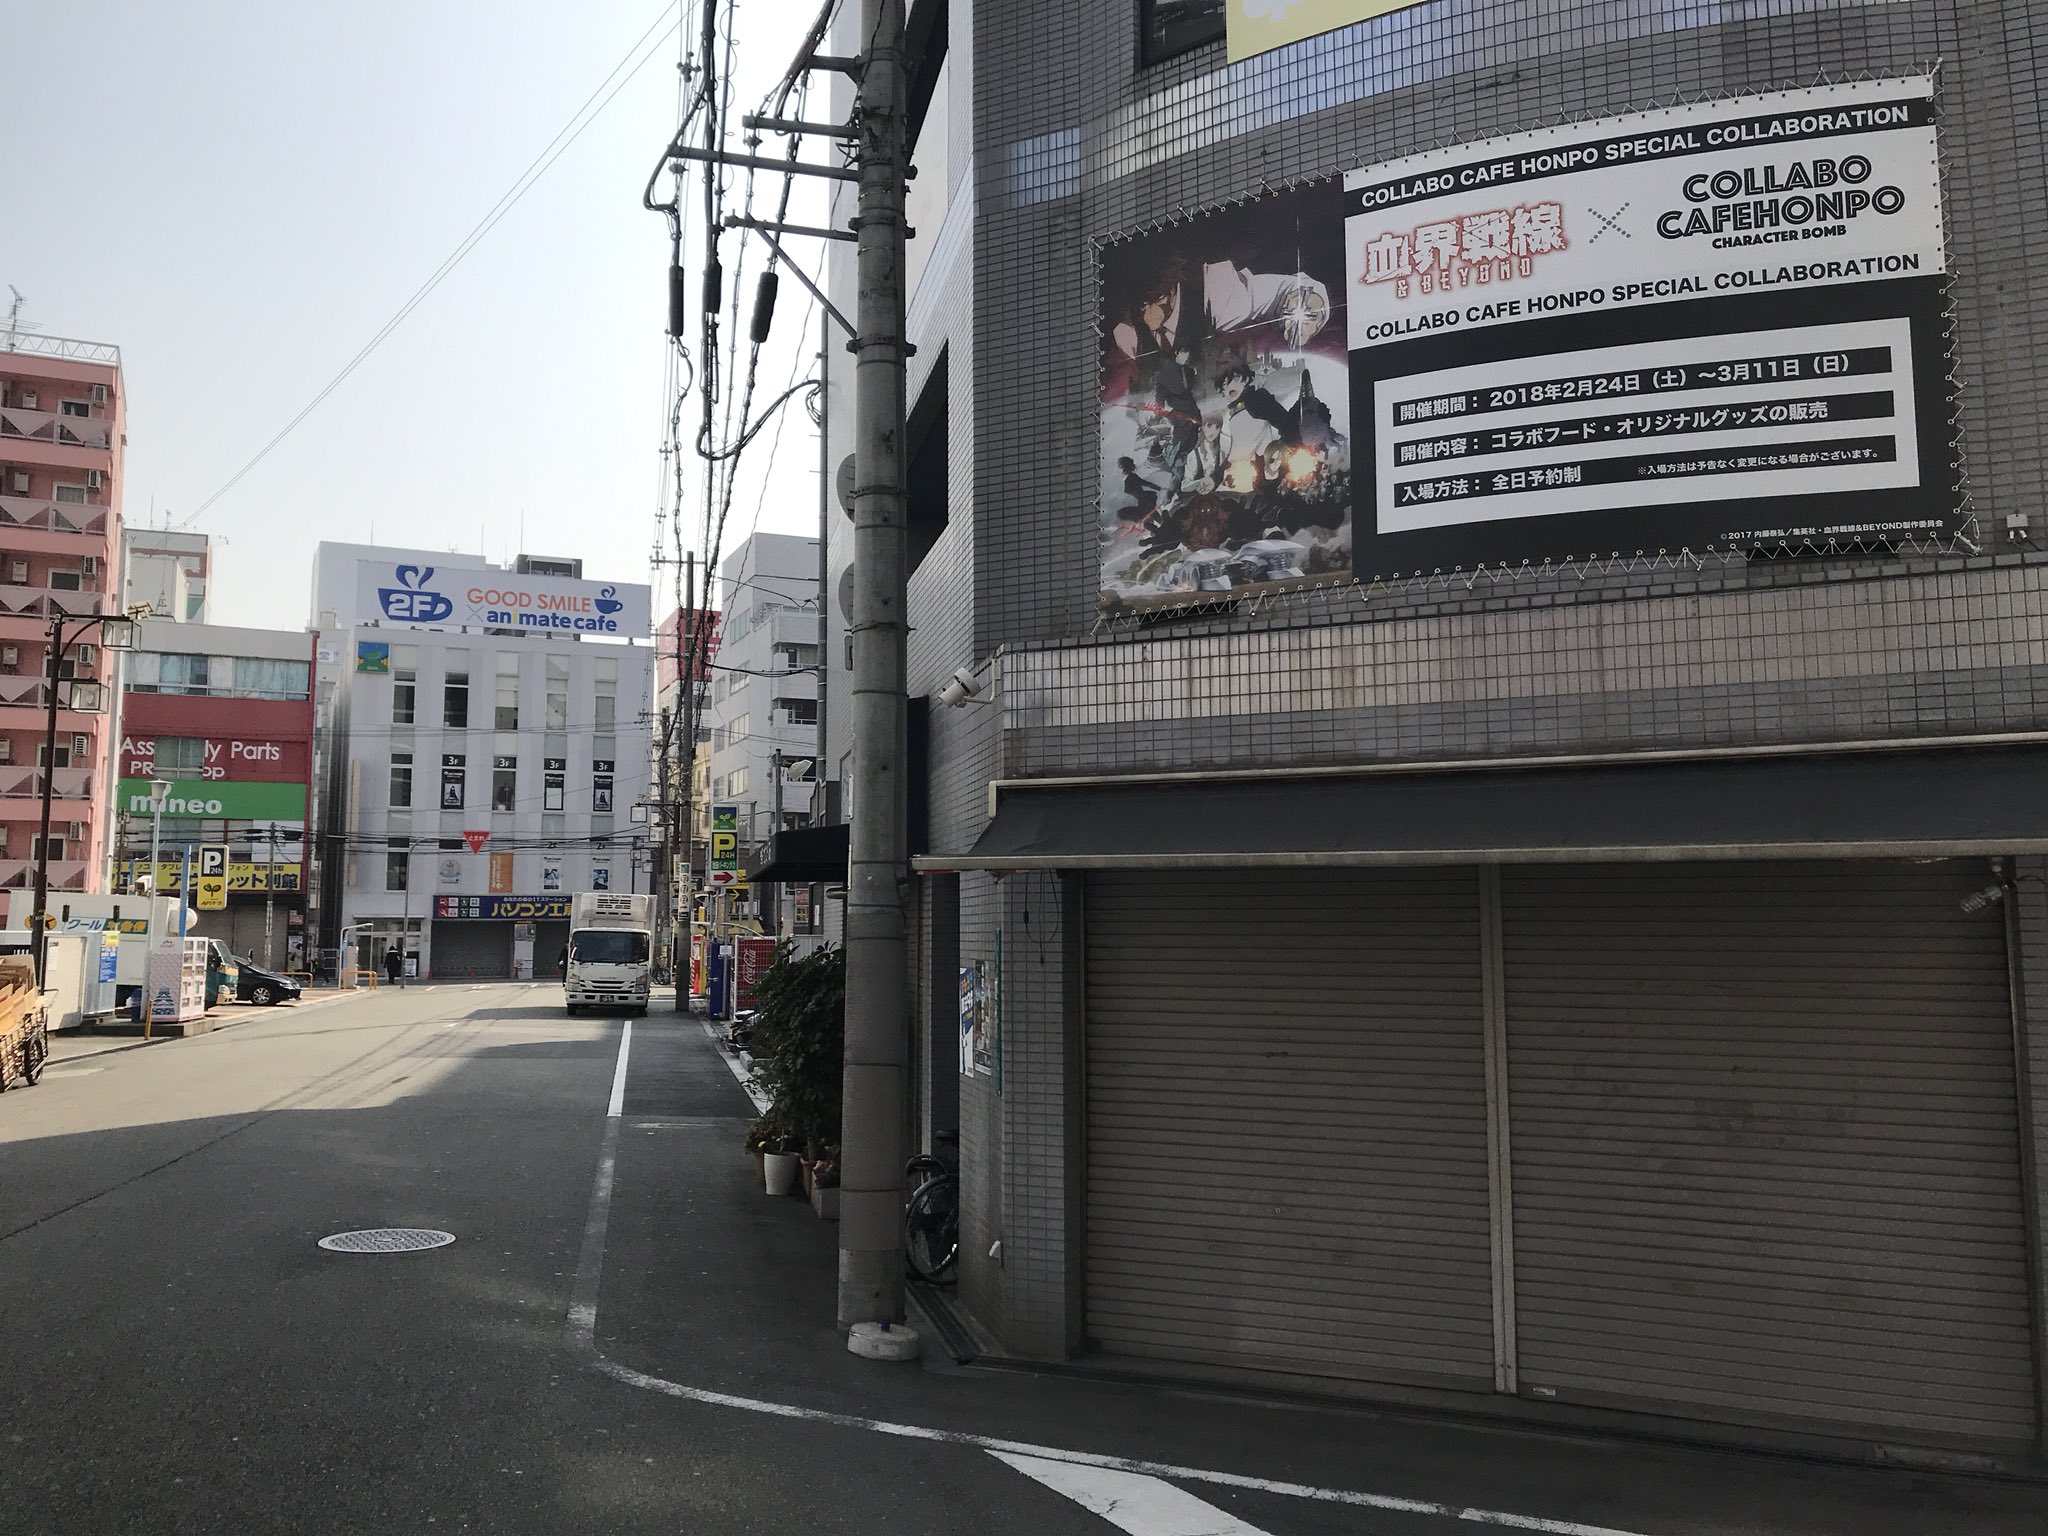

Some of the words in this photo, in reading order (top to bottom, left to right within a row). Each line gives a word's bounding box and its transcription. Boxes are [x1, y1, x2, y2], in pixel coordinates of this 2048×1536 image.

[1361, 173, 1454, 208] COLLABO
[1459, 161, 1515, 186] CAFE
[1521, 147, 1599, 175] HONPO
[1604, 132, 1701, 160] SPECIAL
[1706, 105, 1909, 146] COLLABORATION
[1682, 154, 1872, 202] COLLABO
[1656, 185, 1905, 240] CAFEHONPO
[1712, 230, 1799, 249] CHARACTER
[1801, 225, 1847, 240] BOMB
[1366, 310, 1460, 341] COLLABO
[1465, 300, 1521, 322] CAFE
[1527, 288, 1605, 314] HONPO
[1611, 276, 1708, 302] SPECIAL
[1714, 253, 1919, 289] COLLABORATION
[1491, 401, 1828, 449] コラボフード・オリジナルグッズの販売
[1492, 465, 1581, 491] 全日予約制
[388, 593, 433, 618] 2F
[467, 588, 532, 608] GOOD
[537, 594, 591, 613] SMILE
[231, 741, 280, 761] Parts
[448, 757, 459, 765] 3F
[500, 758, 510, 767] 3F
[550, 760, 560, 769] 3F
[599, 762, 608, 771] 3F
[713, 834, 735, 859] P
[203, 851, 222, 874] P
